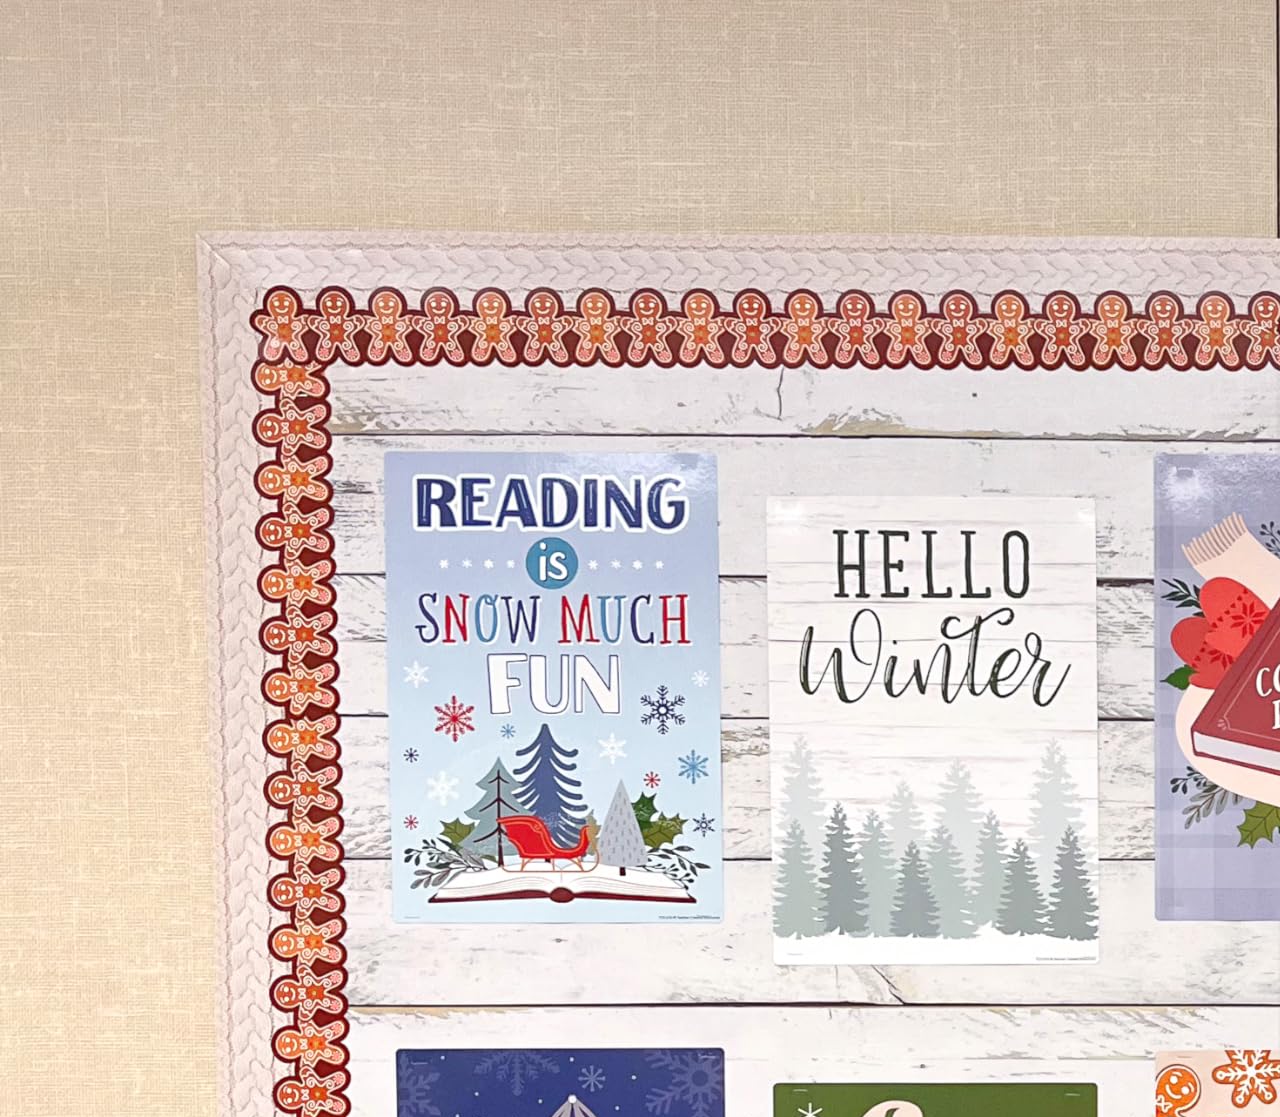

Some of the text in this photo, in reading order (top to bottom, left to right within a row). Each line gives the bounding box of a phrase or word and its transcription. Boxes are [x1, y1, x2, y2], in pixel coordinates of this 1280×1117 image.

[415, 476, 688, 531] READING
[537, 541, 569, 582] is
[833, 529, 1031, 600] HELLO
[416, 593, 692, 645] SNOW MUCH
[486, 651, 622, 716] FUN
[801, 606, 1073, 708] Winter
